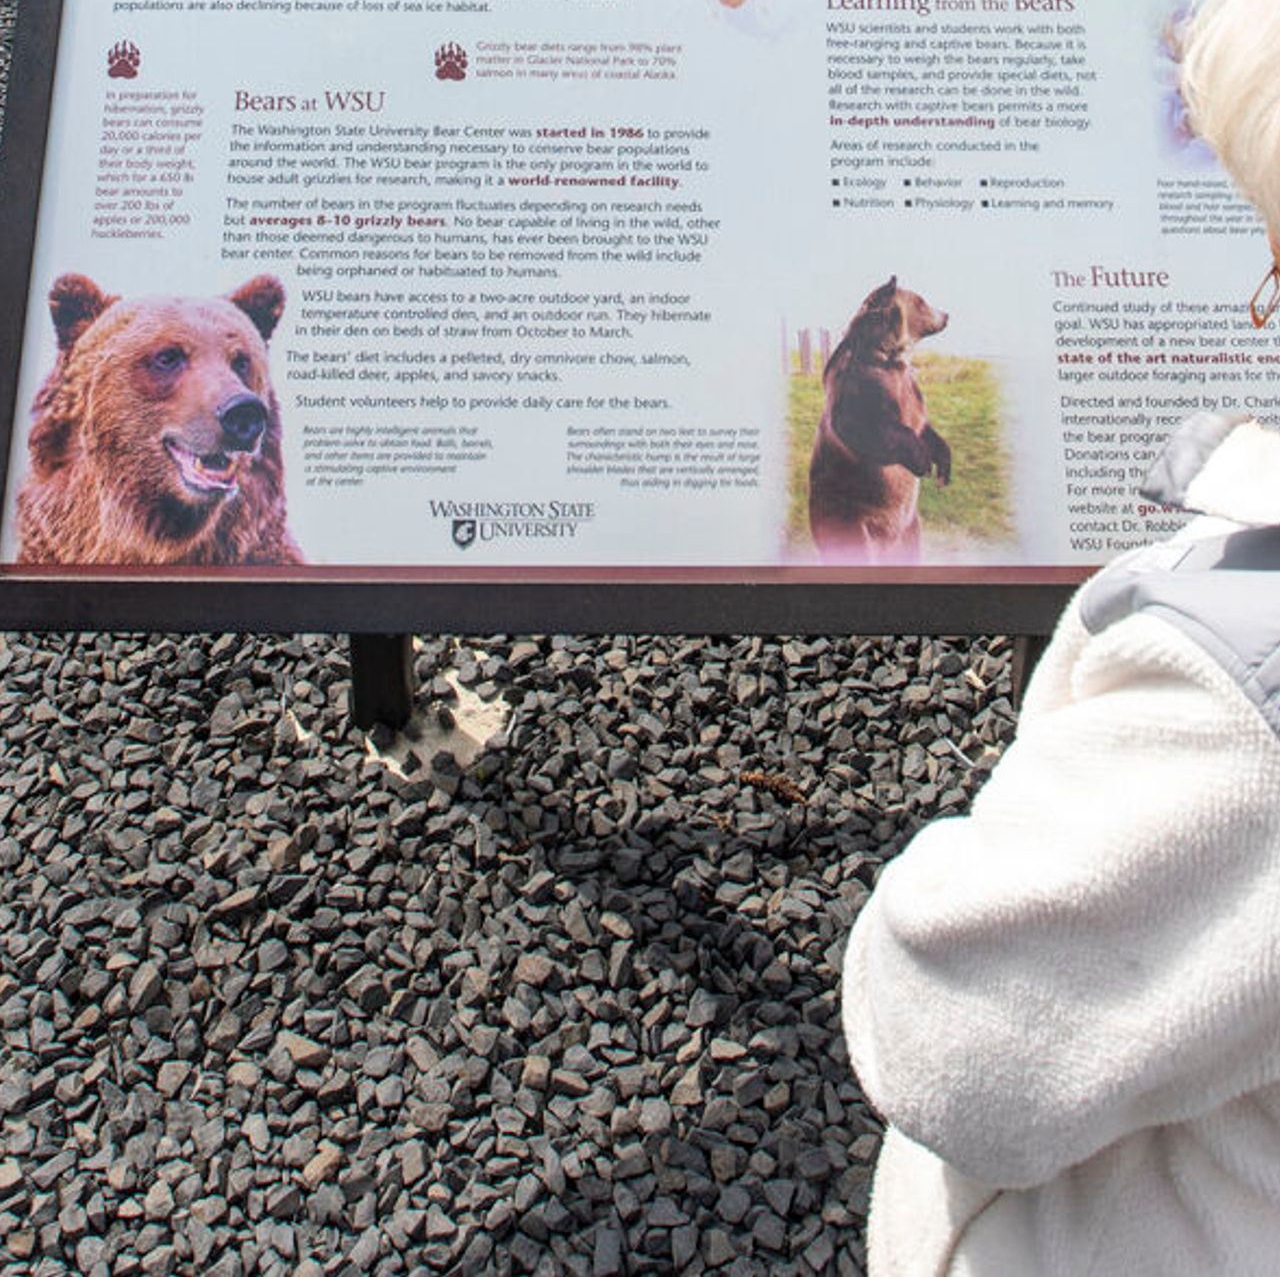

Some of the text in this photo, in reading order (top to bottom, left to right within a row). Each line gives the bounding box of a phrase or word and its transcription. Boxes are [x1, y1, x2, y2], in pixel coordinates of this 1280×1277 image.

[825, 22, 1086, 35] WSU scientists and students work with both
[182, 91, 197, 104] for
[234, 90, 386, 112] Bears at WSU
[892, 116, 995, 129] understanding
[998, 116, 1010, 127] of
[1014, 116, 1041, 127] bear
[140, 130, 182, 141] calories
[183, 132, 202, 143] per
[231, 124, 710, 141] The Washington State University Bear Center was started in 1986 to provide
[829, 139, 1040, 151] Areas of research conducted in the
[830, 157, 884, 170] program
[226, 172, 264, 184] house
[266, 173, 299, 184] adult
[302, 173, 352, 188] grizzlies
[354, 173, 372, 185] for
[434, 174, 481, 188] making
[484, 174, 494, 185] it
[496, 176, 505, 185] a
[507, 174, 626, 186] world-renowned
[842, 176, 887, 190] Ecology
[914, 176, 962, 188] Behavior
[989, 176, 1065, 190] Reproduction
[842, 197, 894, 208] Nutrition
[914, 196, 975, 210] Physiology
[990, 197, 1114, 211] Learning and memory
[129, 215, 142, 224] or
[223, 214, 245, 225] but
[248, 216, 312, 229] averages
[354, 215, 403, 230] grizzly
[453, 215, 473, 227] No
[476, 215, 505, 227] bear
[508, 216, 556, 230] capable
[560, 216, 572, 227] of
[575, 216, 610, 231] living
[612, 216, 625, 228] in
[629, 216, 650, 228] the
[686, 217, 720, 228] other
[1050, 265, 1169, 287] The Future
[301, 290, 690, 307] WSU bears have access to a two-acre outdoor yard, an indoor
[1056, 352, 1094, 364] state
[1097, 351, 1112, 364] of
[1116, 351, 1142, 364] the
[1145, 353, 1166, 364] art
[1170, 351, 1253, 364] naturalistic
[1057, 368, 1095, 384] larger
[1097, 368, 1150, 381] outdoor
[1152, 368, 1206, 384] foraging
[1208, 371, 1242, 381] areas
[1243, 368, 1262, 381] for
[294, 395, 346, 408] Student
[349, 395, 417, 408] volunteers
[419, 395, 449, 411] help
[451, 397, 466, 408] to
[468, 395, 519, 411] provide
[520, 395, 554, 411] daily
[555, 397, 584, 408] care
[586, 396, 605, 408] for
[608, 396, 630, 409] the
[1060, 395, 1114, 408] Directed
[1117, 395, 1143, 408] and
[1144, 395, 1199, 408] founded
[1202, 395, 1218, 412] by
[1221, 395, 1240, 408] Dr.
[1069, 520, 1119, 532] contact
[1121, 518, 1140, 532] Dr.
